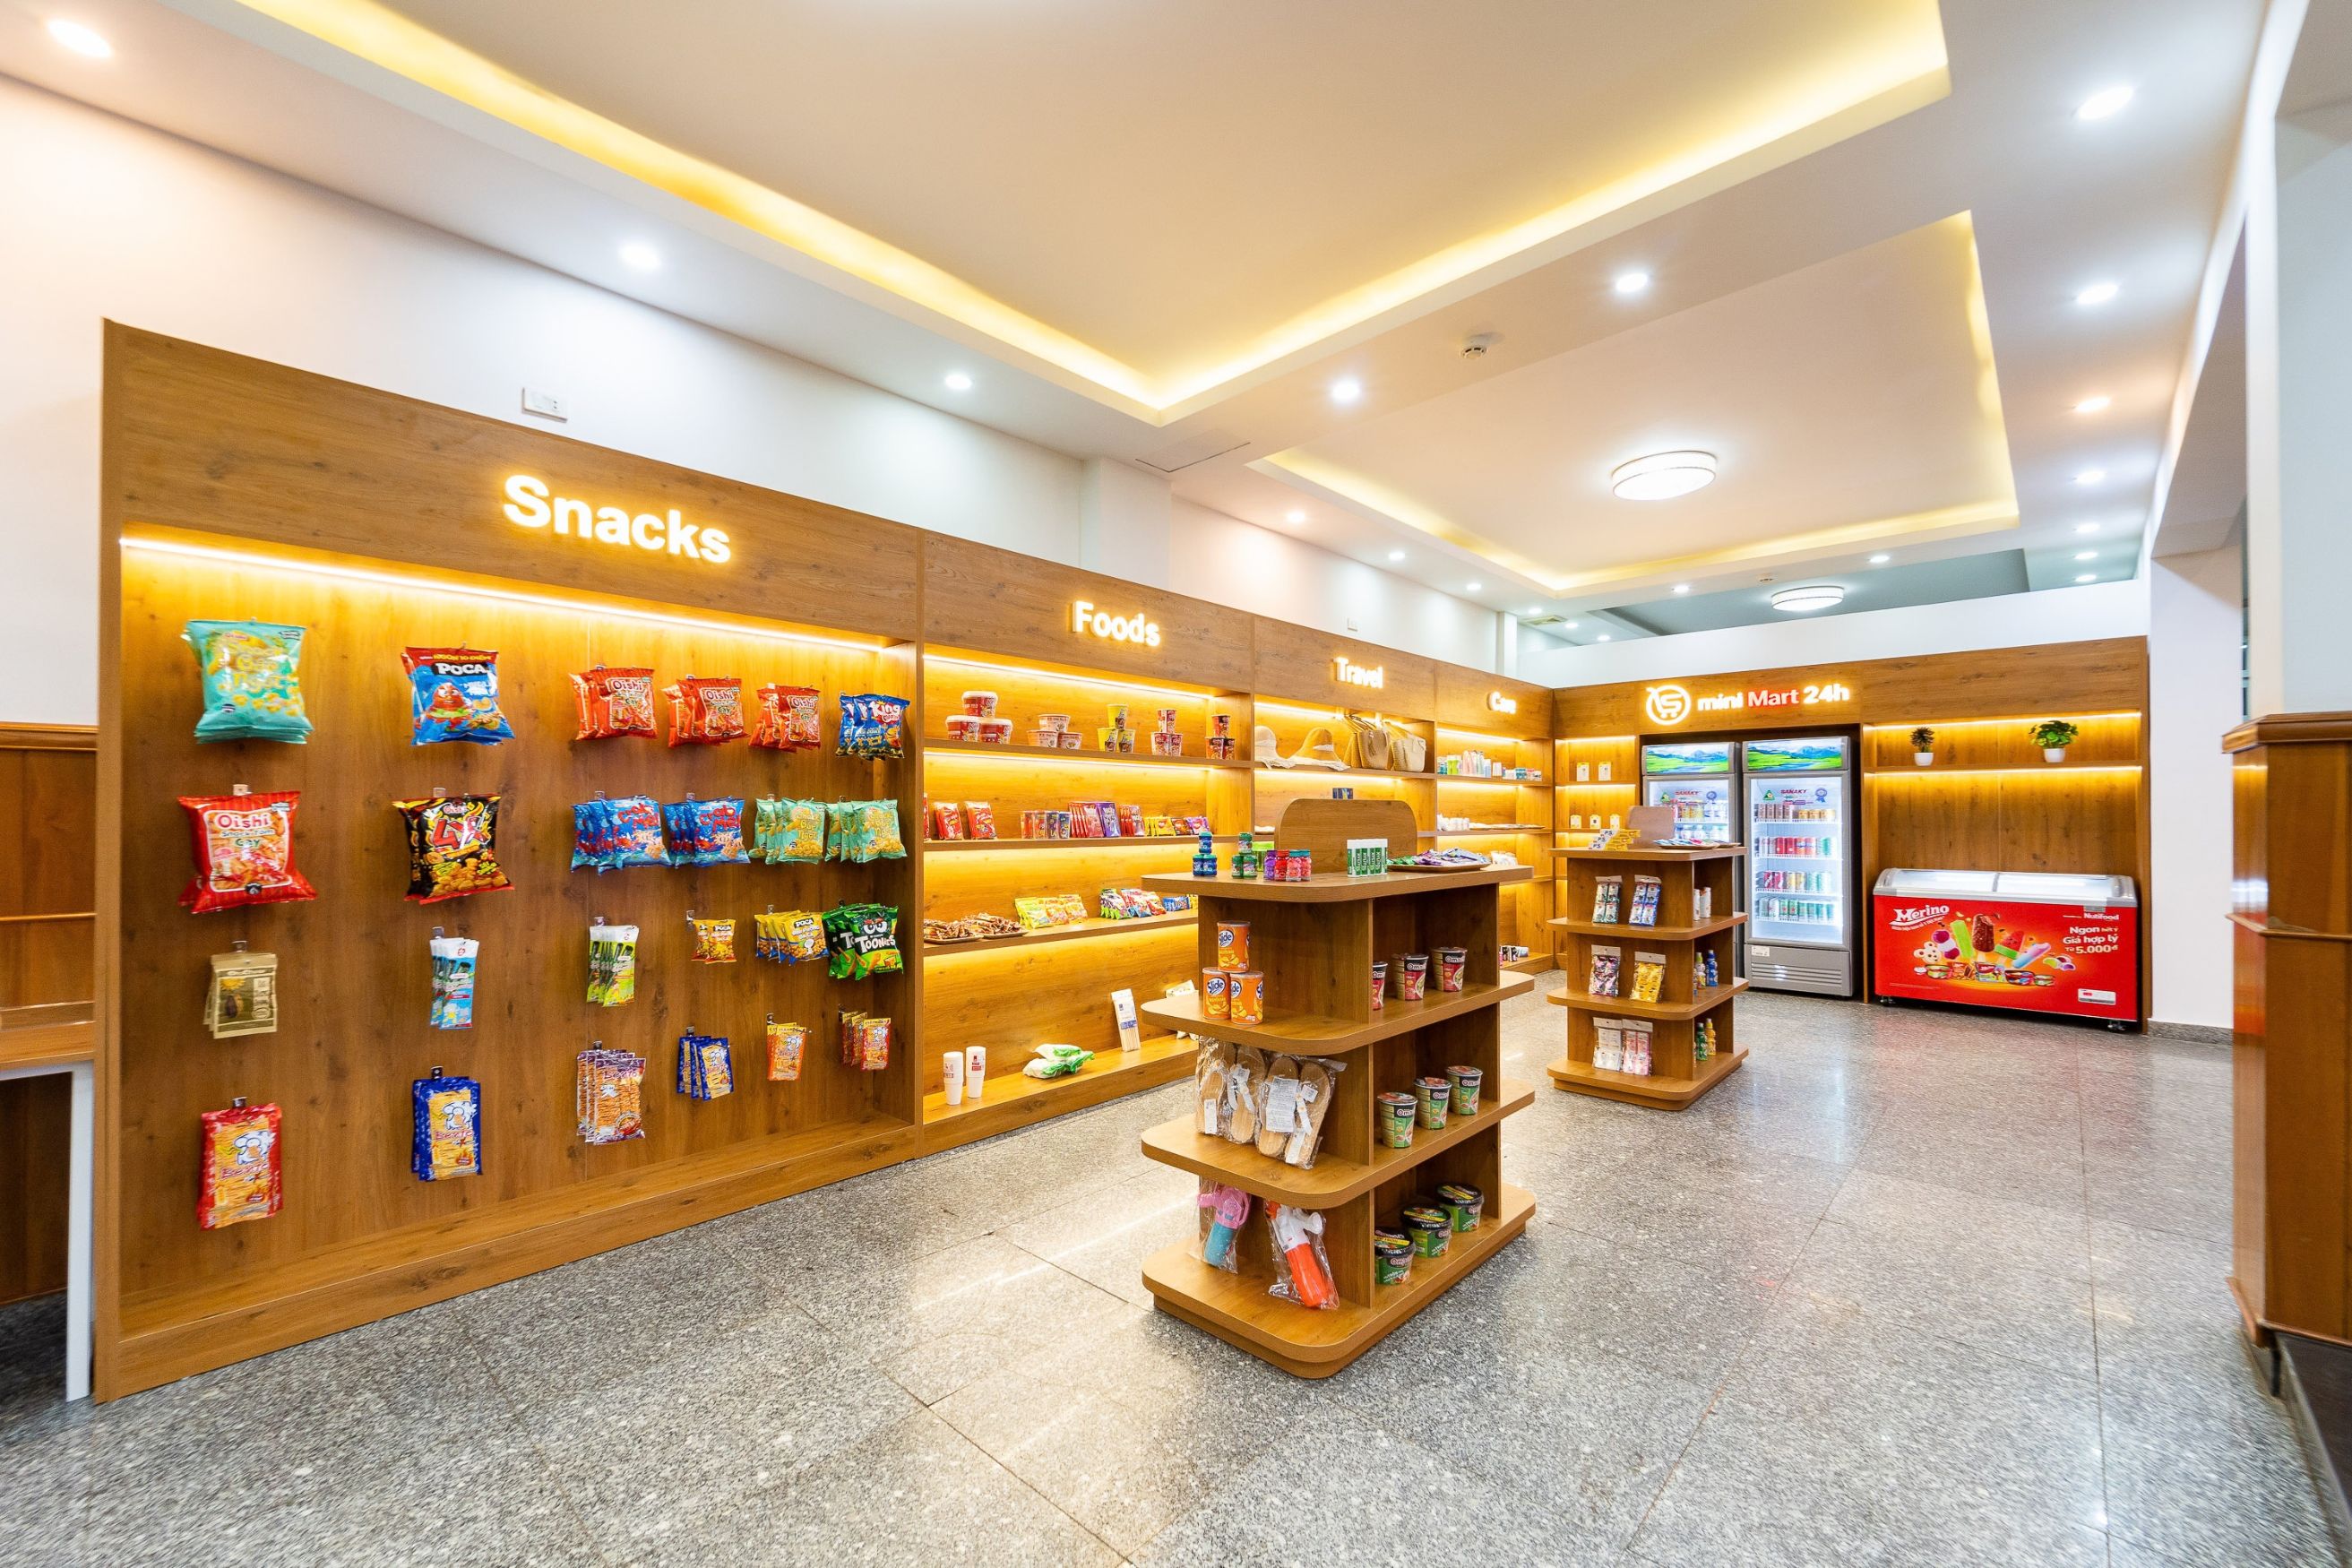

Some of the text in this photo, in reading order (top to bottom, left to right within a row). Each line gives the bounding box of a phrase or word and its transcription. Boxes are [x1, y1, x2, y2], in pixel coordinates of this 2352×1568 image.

[503, 474, 731, 564] Snacks
[1073, 600, 1161, 647] Foods
[435, 662, 487, 676] POCA
[1334, 656, 1383, 689] Travel
[613, 679, 642, 691] Oishi
[705, 690, 733, 700] Oishi
[793, 697, 814, 708] Oishi
[1697, 683, 1850, 711] mini Mart 24h
[869, 700, 901, 718] King
[218, 813, 270, 829] Oishi
[699, 804, 737, 826] Crab
[1893, 904, 1950, 922] Merino
[796, 918, 814, 927] POCA
[2070, 926, 2100, 935] Ngon
[2063, 934, 2119, 944] Giá hợp lý
[1207, 979, 1224, 994] Slide
